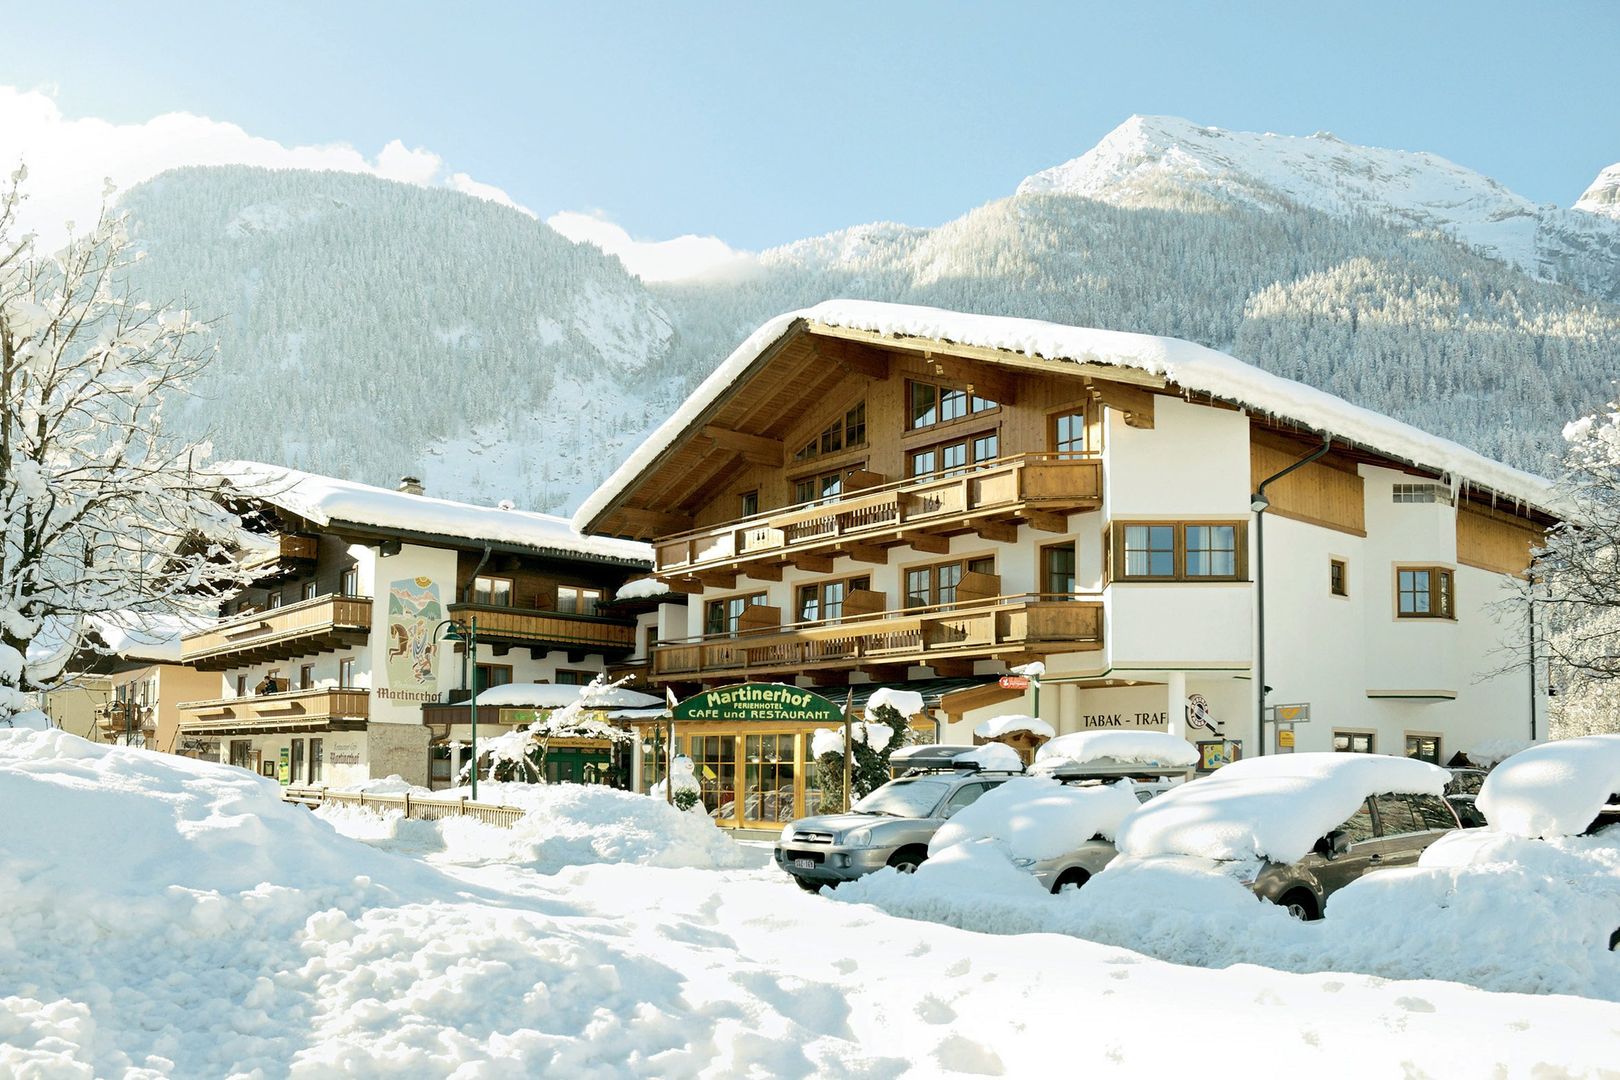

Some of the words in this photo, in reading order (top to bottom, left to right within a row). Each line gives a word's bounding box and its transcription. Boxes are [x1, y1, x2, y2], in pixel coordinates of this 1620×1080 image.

[707, 686, 812, 707] Martinerhof
[733, 702, 784, 710] FERIENHOTEL
[688, 709, 719, 718] CAFE
[723, 710, 746, 719] und
[750, 710, 830, 719] RESTAURANT
[1083, 714, 1122, 727] TABAK
